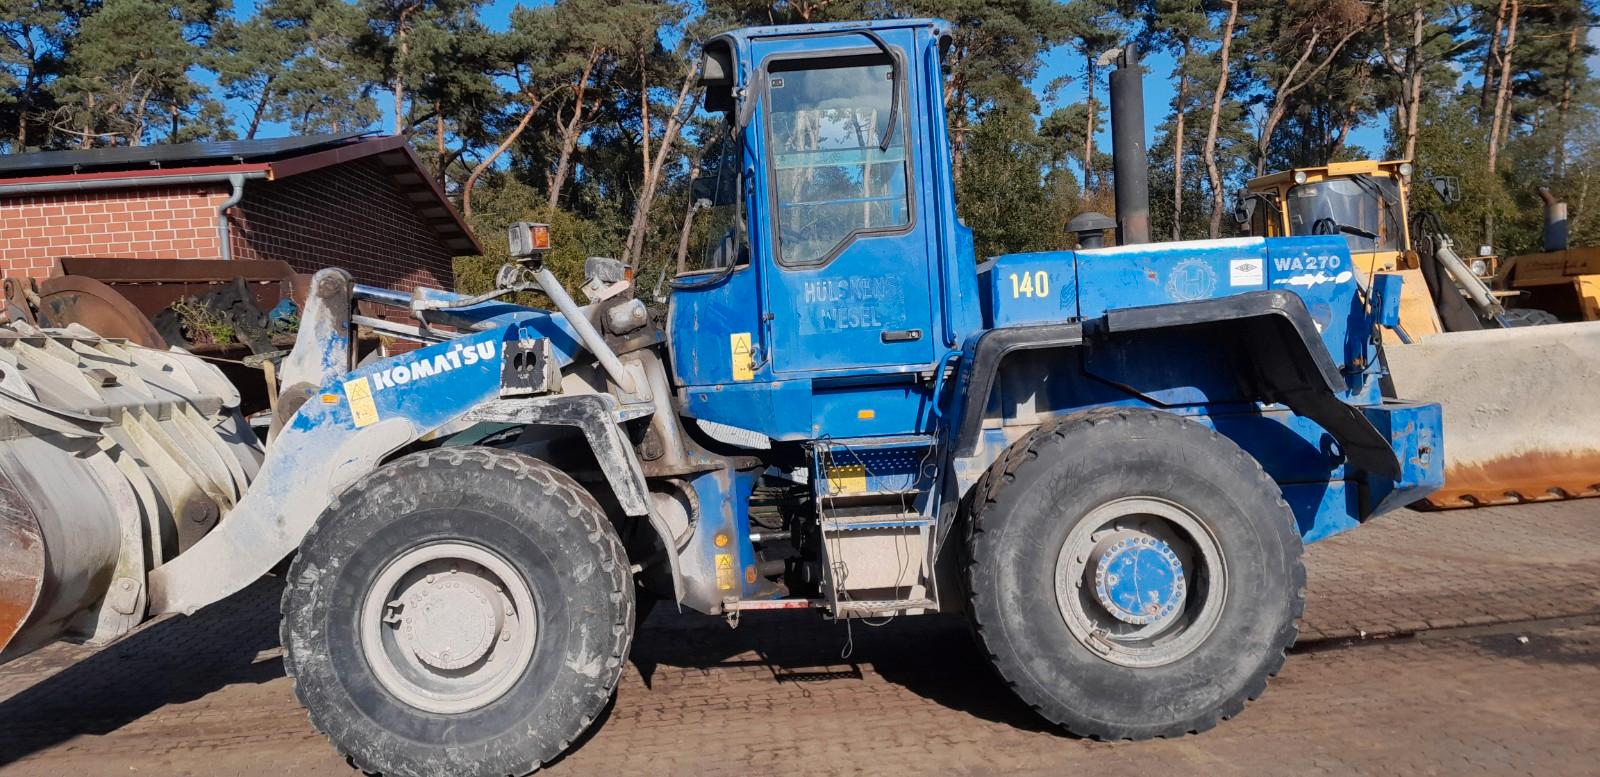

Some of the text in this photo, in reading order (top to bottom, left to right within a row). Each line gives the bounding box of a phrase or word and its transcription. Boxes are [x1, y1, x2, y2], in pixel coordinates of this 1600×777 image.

[1273, 256, 1303, 272] WA
[1305, 255, 1341, 270] 270
[1009, 270, 1049, 299] 140
[373, 340, 497, 391] KOMATSU
